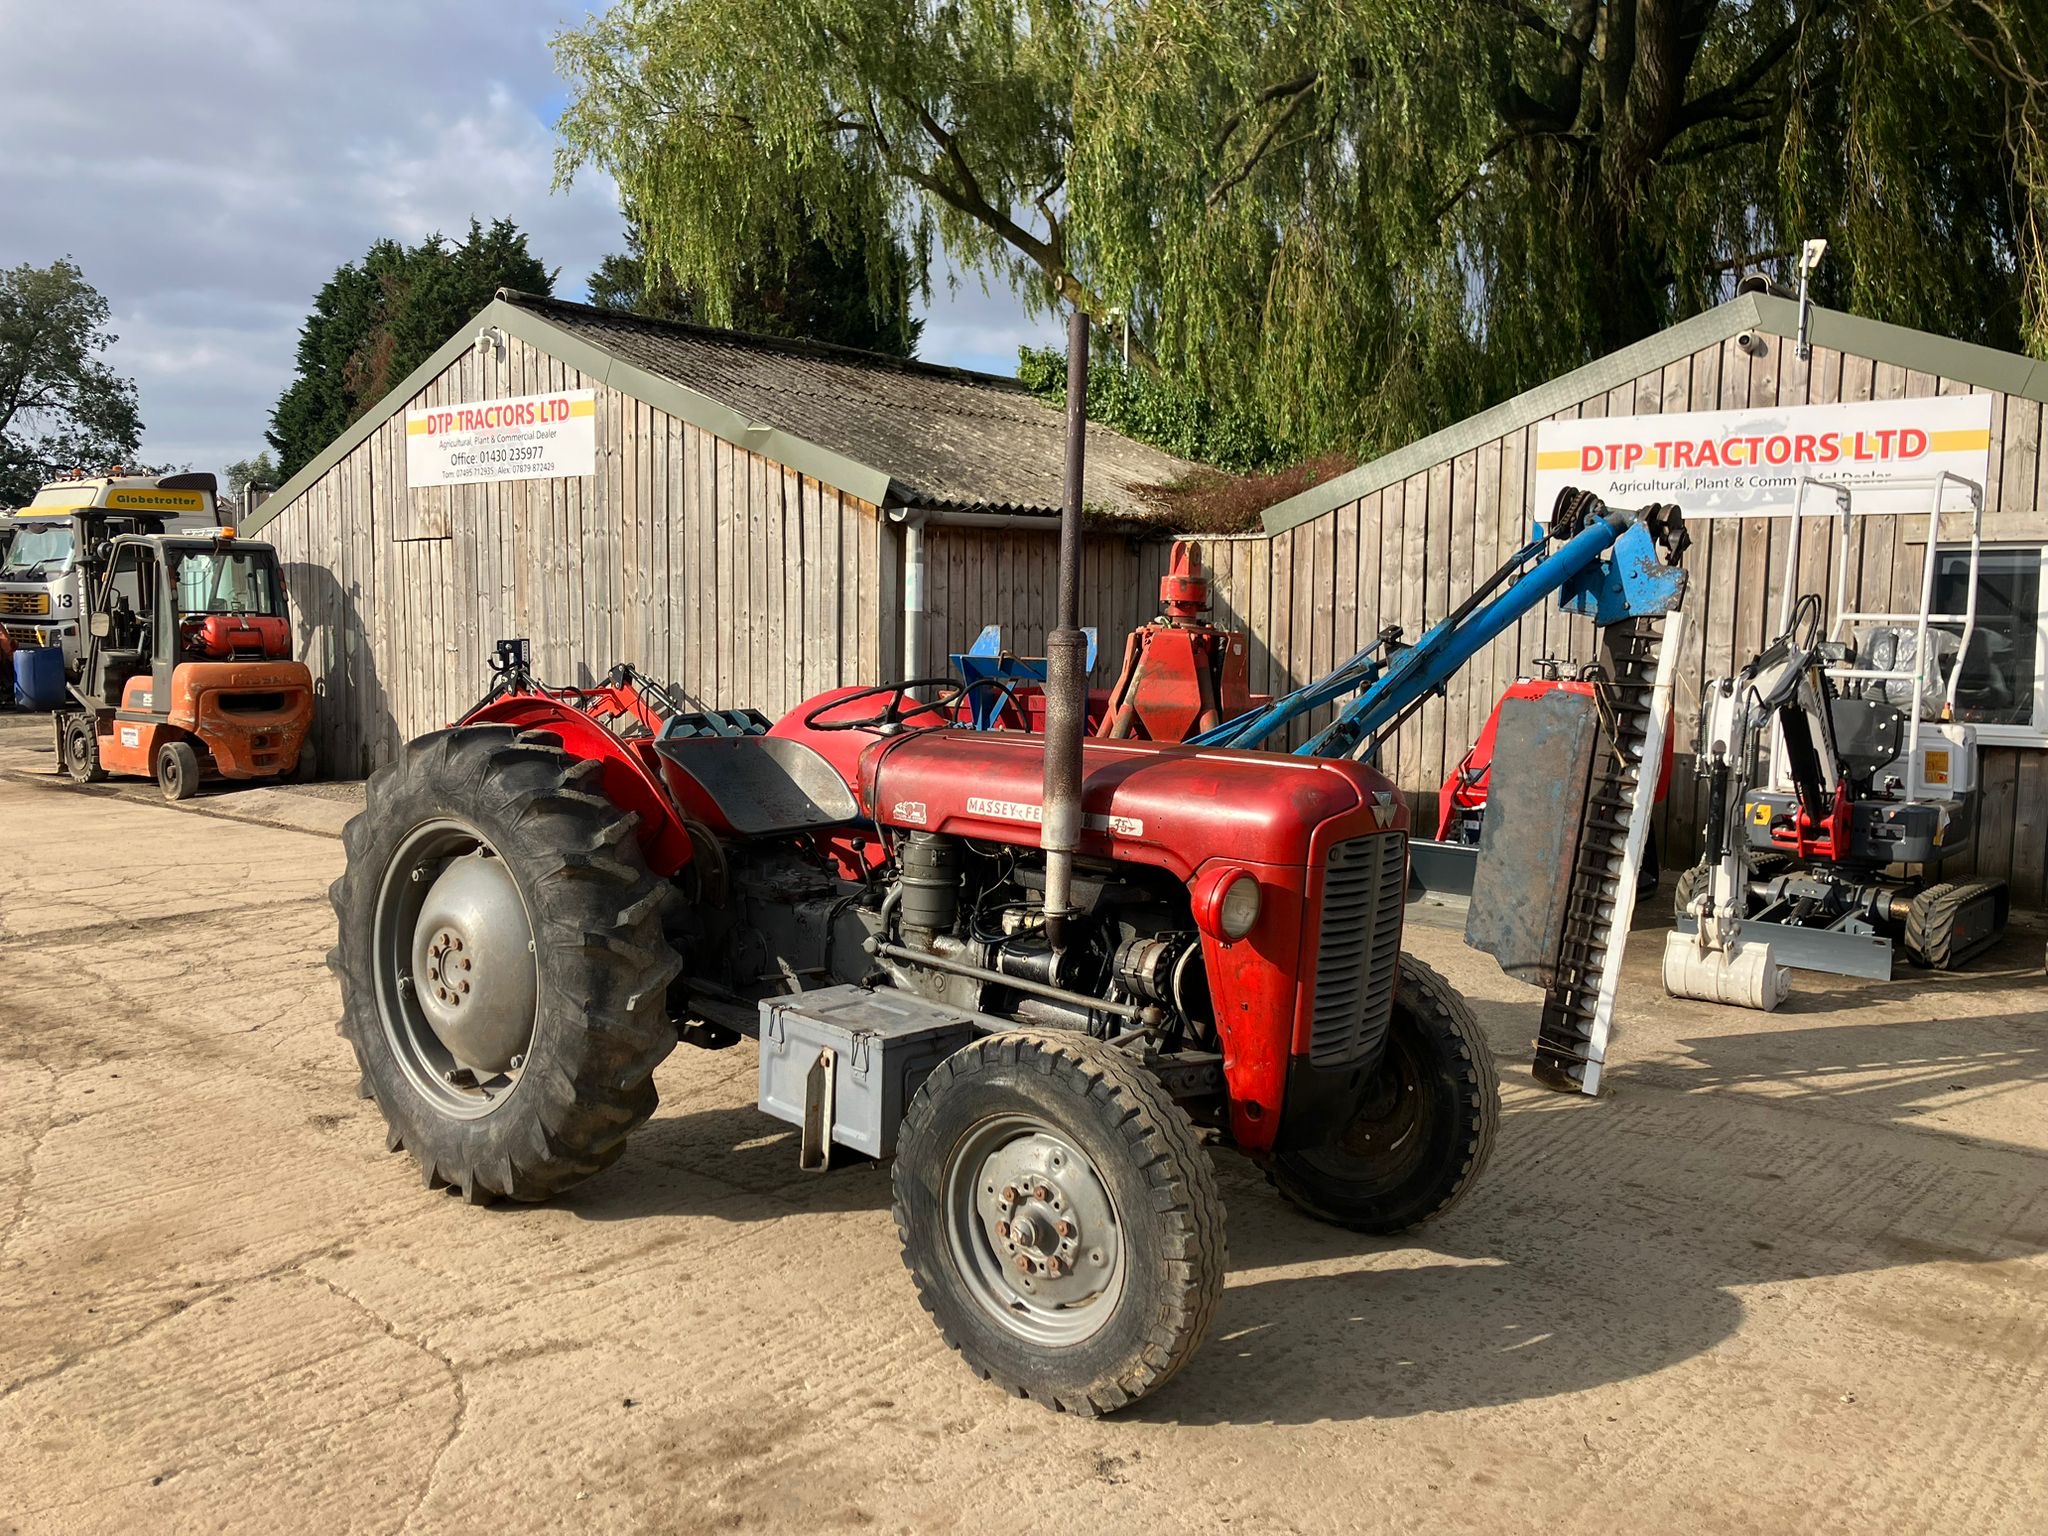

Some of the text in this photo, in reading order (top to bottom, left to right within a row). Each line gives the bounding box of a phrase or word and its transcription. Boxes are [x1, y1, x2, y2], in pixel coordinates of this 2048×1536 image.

[427, 399, 570, 435] DTP TRACTORS LTD
[439, 429, 557, 450] Agricultural, Plant & Commercial Dealer
[451, 446, 543, 466] Office: 01430 235977
[1581, 428, 1928, 472] DTP TRACTORS LTD
[512, 464, 531, 474] 07879
[532, 462, 555, 472] 872429
[1609, 478, 1690, 494] Agricultural,
[1695, 477, 1729, 489] Plant
[1734, 476, 1744, 487] &
[116, 495, 196, 505] Globetrotter
[57, 594, 73, 608] 13
